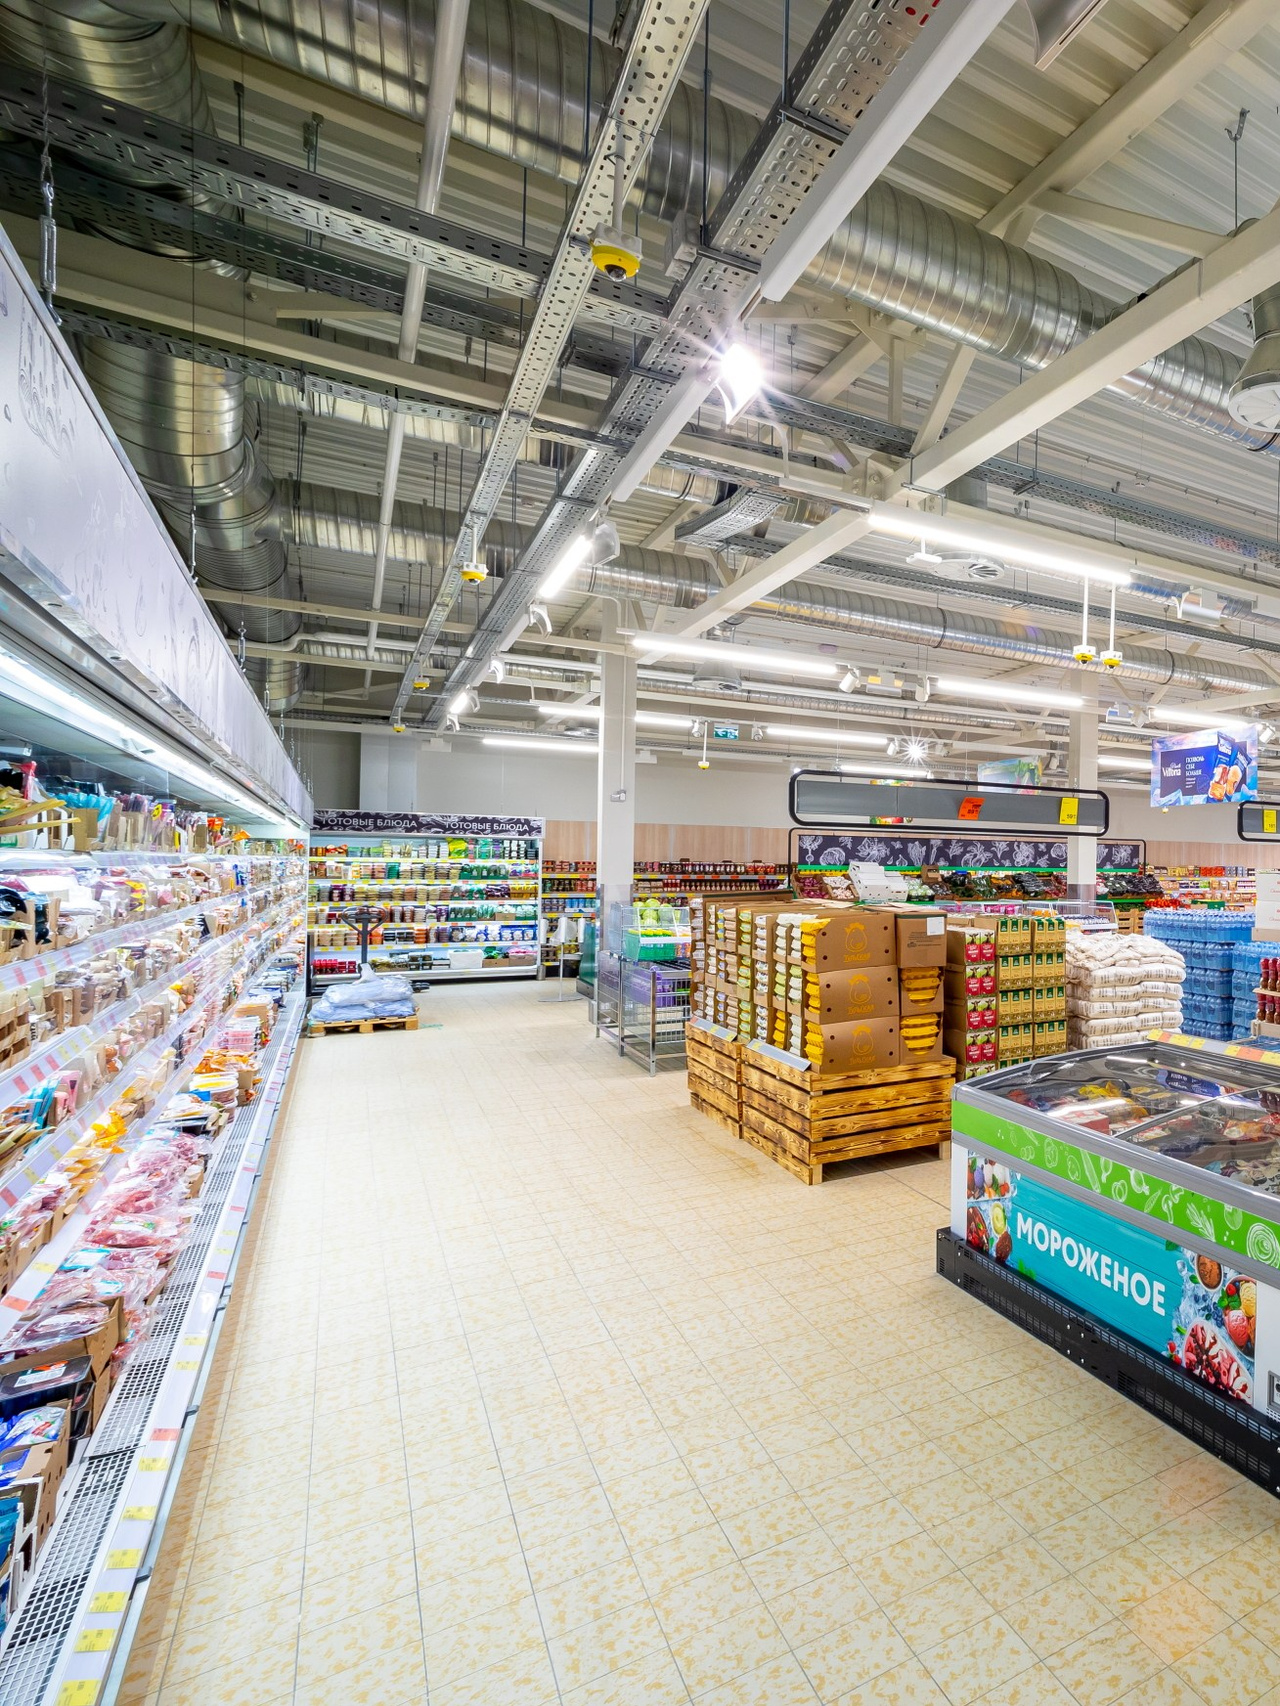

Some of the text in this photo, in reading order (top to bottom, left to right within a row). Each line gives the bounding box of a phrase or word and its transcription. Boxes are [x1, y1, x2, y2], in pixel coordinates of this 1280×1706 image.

[322, 817, 418, 828] ГОТОВЫЕ БЛЮДА
[445, 821, 529, 832] ГОТОВЫЕ БЛЮДА
[1016, 1212, 1166, 1317] МОРОЖЕНОЕ
